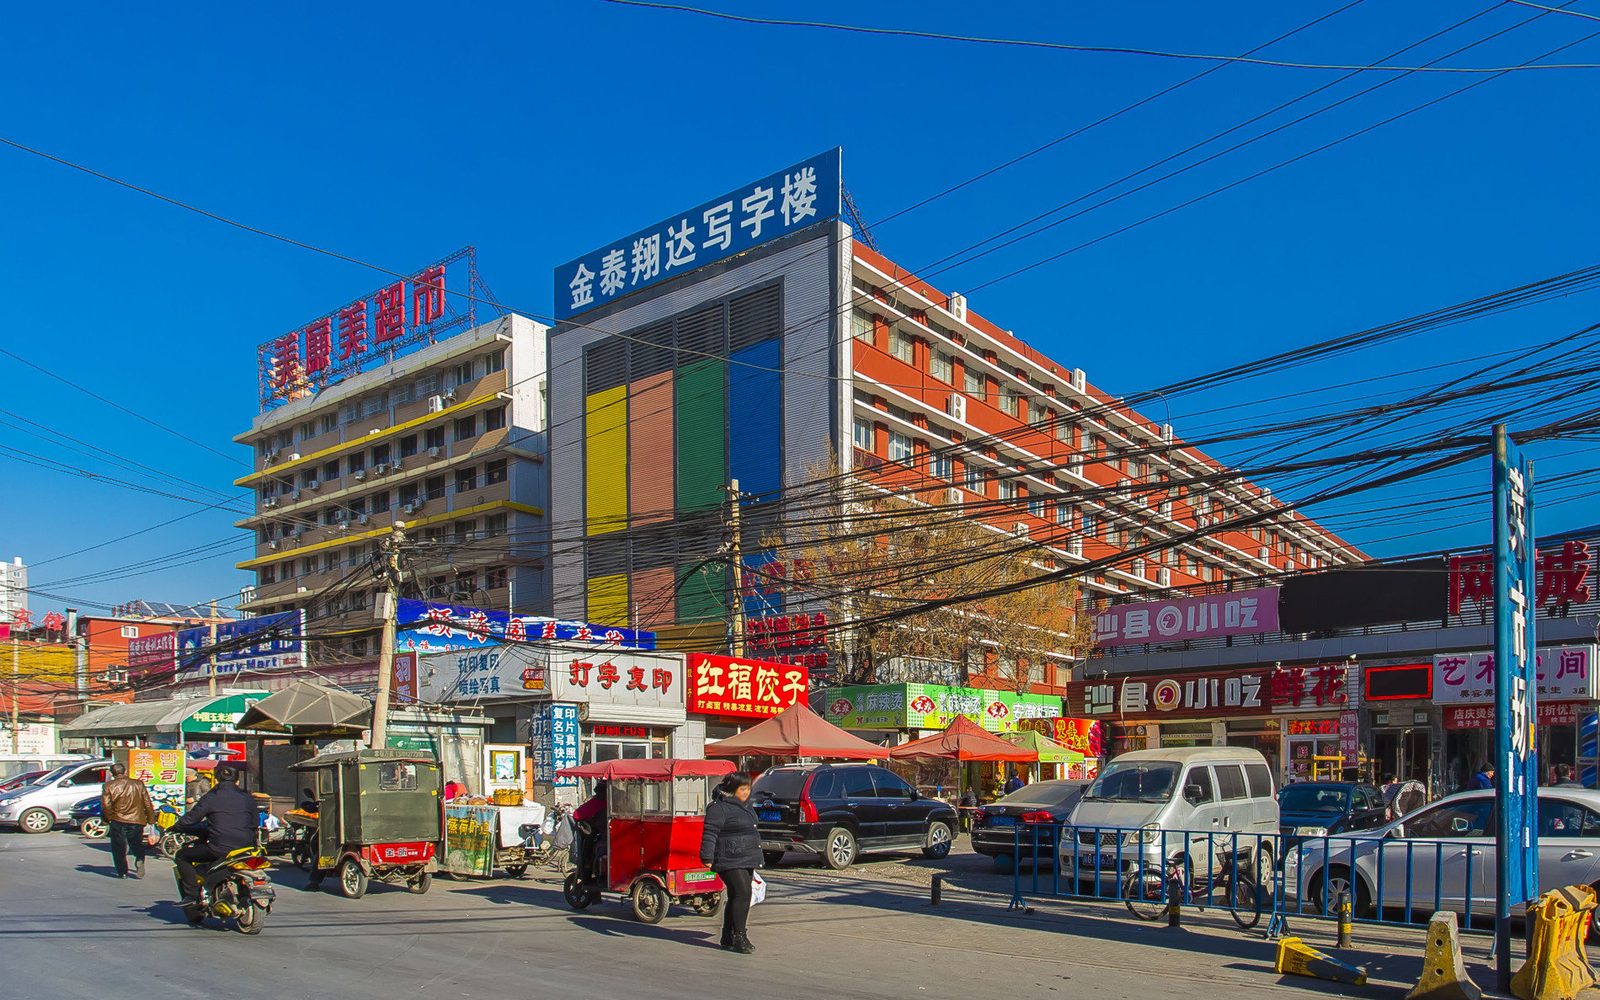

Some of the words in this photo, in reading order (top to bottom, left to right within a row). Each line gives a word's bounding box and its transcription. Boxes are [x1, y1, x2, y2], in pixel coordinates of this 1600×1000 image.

[568, 166, 818, 310] 金泰翔达写字楼
[275, 265, 446, 388] 美廉美超市
[1090, 597, 1258, 641] 沙县小吃
[246, 656, 279, 670] Mart
[458, 653, 500, 674] 打印复印
[568, 658, 673, 695] 打字复印
[1438, 650, 1587, 687] 艺术间
[696, 658, 806, 706] 红福饺子
[1084, 674, 1262, 715] 沙县小吃
[1271, 665, 1348, 706] 鲜花
[553, 707, 576, 720] 复印
[866, 692, 903, 712] 麻辣烫
[553, 721, 576, 733] 名片
[553, 734, 576, 746] 写真
[554, 747, 577, 759] 快照
[136, 768, 178, 783] 寿司
